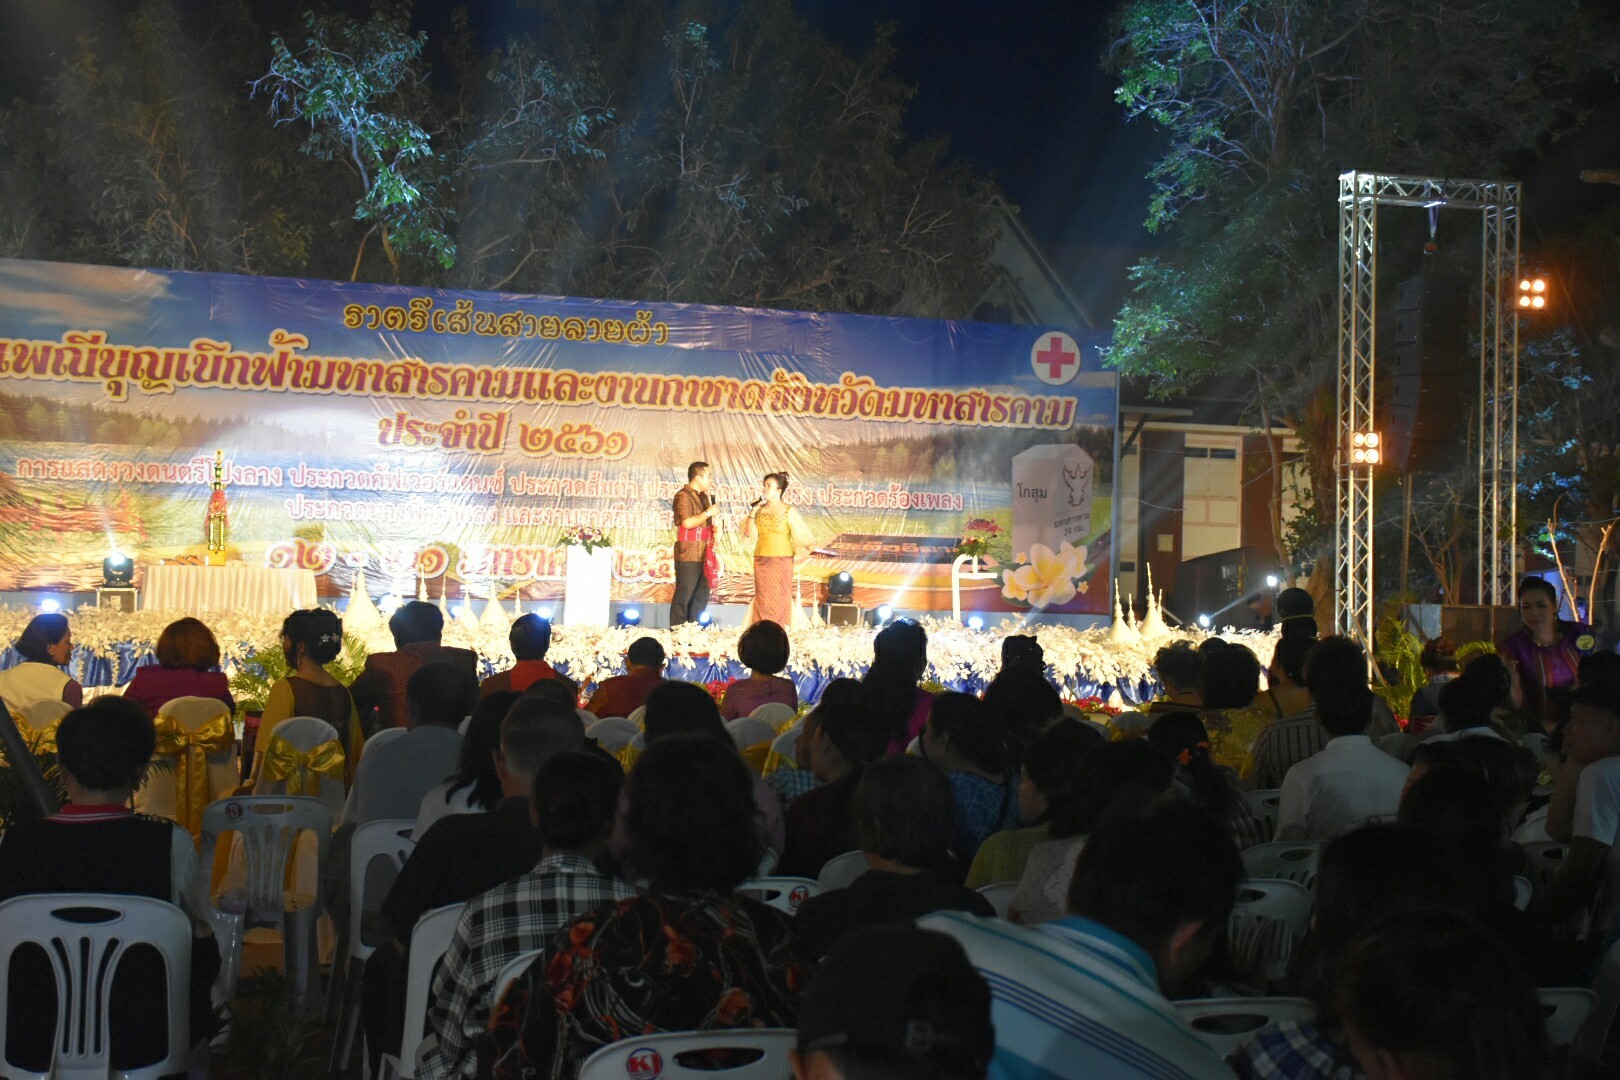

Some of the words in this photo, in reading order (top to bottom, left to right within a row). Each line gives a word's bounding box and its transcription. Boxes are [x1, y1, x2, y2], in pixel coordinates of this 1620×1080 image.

[343, 297, 669, 345] ราตรีเส้นสายลายผ้า
[378, 408, 508, 451] ประจำปี
[819, 481, 963, 511] ประกวดร้องเพลง
[1017, 482, 1047, 503] โกสุม
